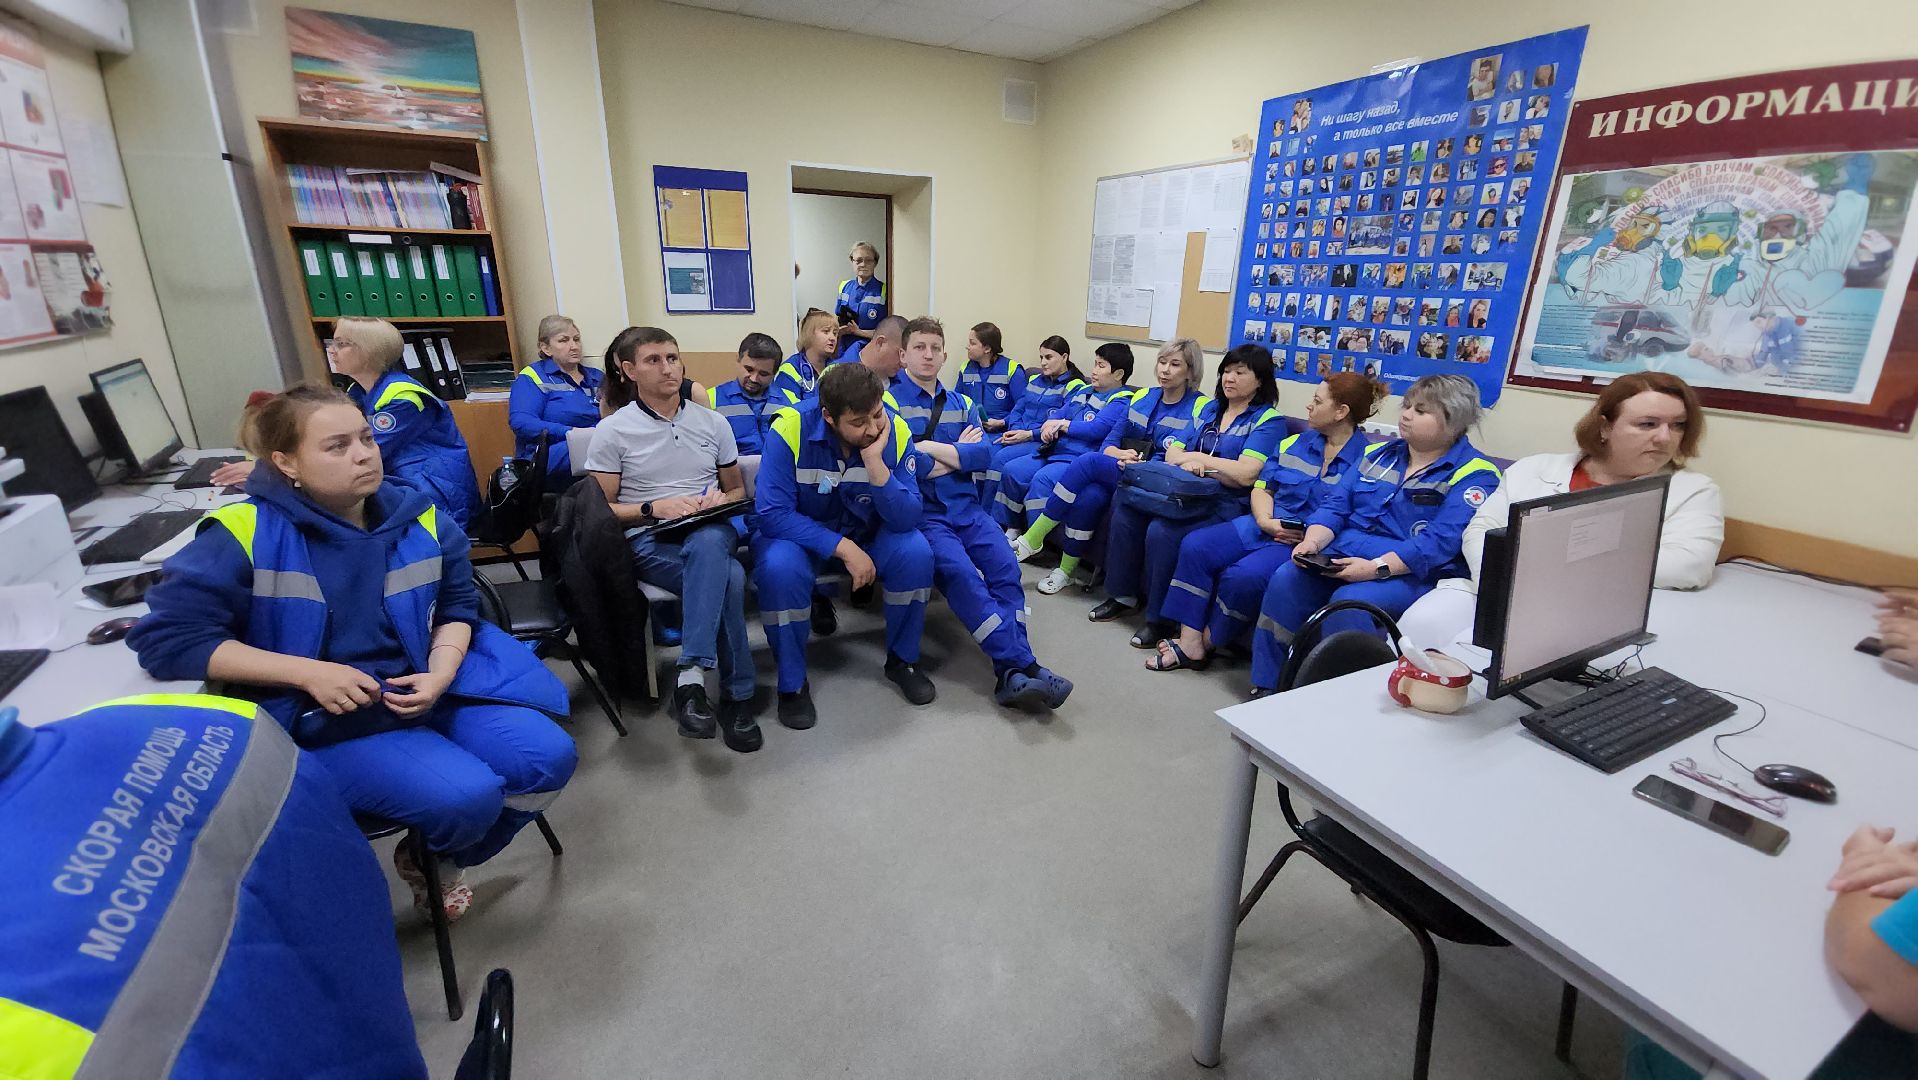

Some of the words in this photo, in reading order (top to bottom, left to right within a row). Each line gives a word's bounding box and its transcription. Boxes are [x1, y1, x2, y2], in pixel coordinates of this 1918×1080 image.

[1320, 115, 1334, 127] Ни
[1336, 109, 1366, 123] шагу
[1366, 100, 1400, 119] назад,
[1333, 131, 1341, 141] а
[1342, 124, 1383, 140] только
[1384, 120, 1405, 133] все
[1406, 111, 1459, 129] вместе
[1588, 78, 1918, 138] ИНФОРМАЦИ
[1614, 194, 1650, 231] ПАСИБО
[1652, 166, 1702, 197] СПАСИБО
[1706, 162, 1753, 177] ВРАЧАМ
[1649, 186, 1681, 207] РАЧАМ
[1689, 173, 1736, 189] СПАСИБО
[52, 788, 144, 895] СКОРАЯ
[123, 726, 188, 793] ПОМОЩЬ
[78, 786, 199, 962] МОСКОВСКАЯ
[181, 725, 234, 791] ОБЛАСТЬ
